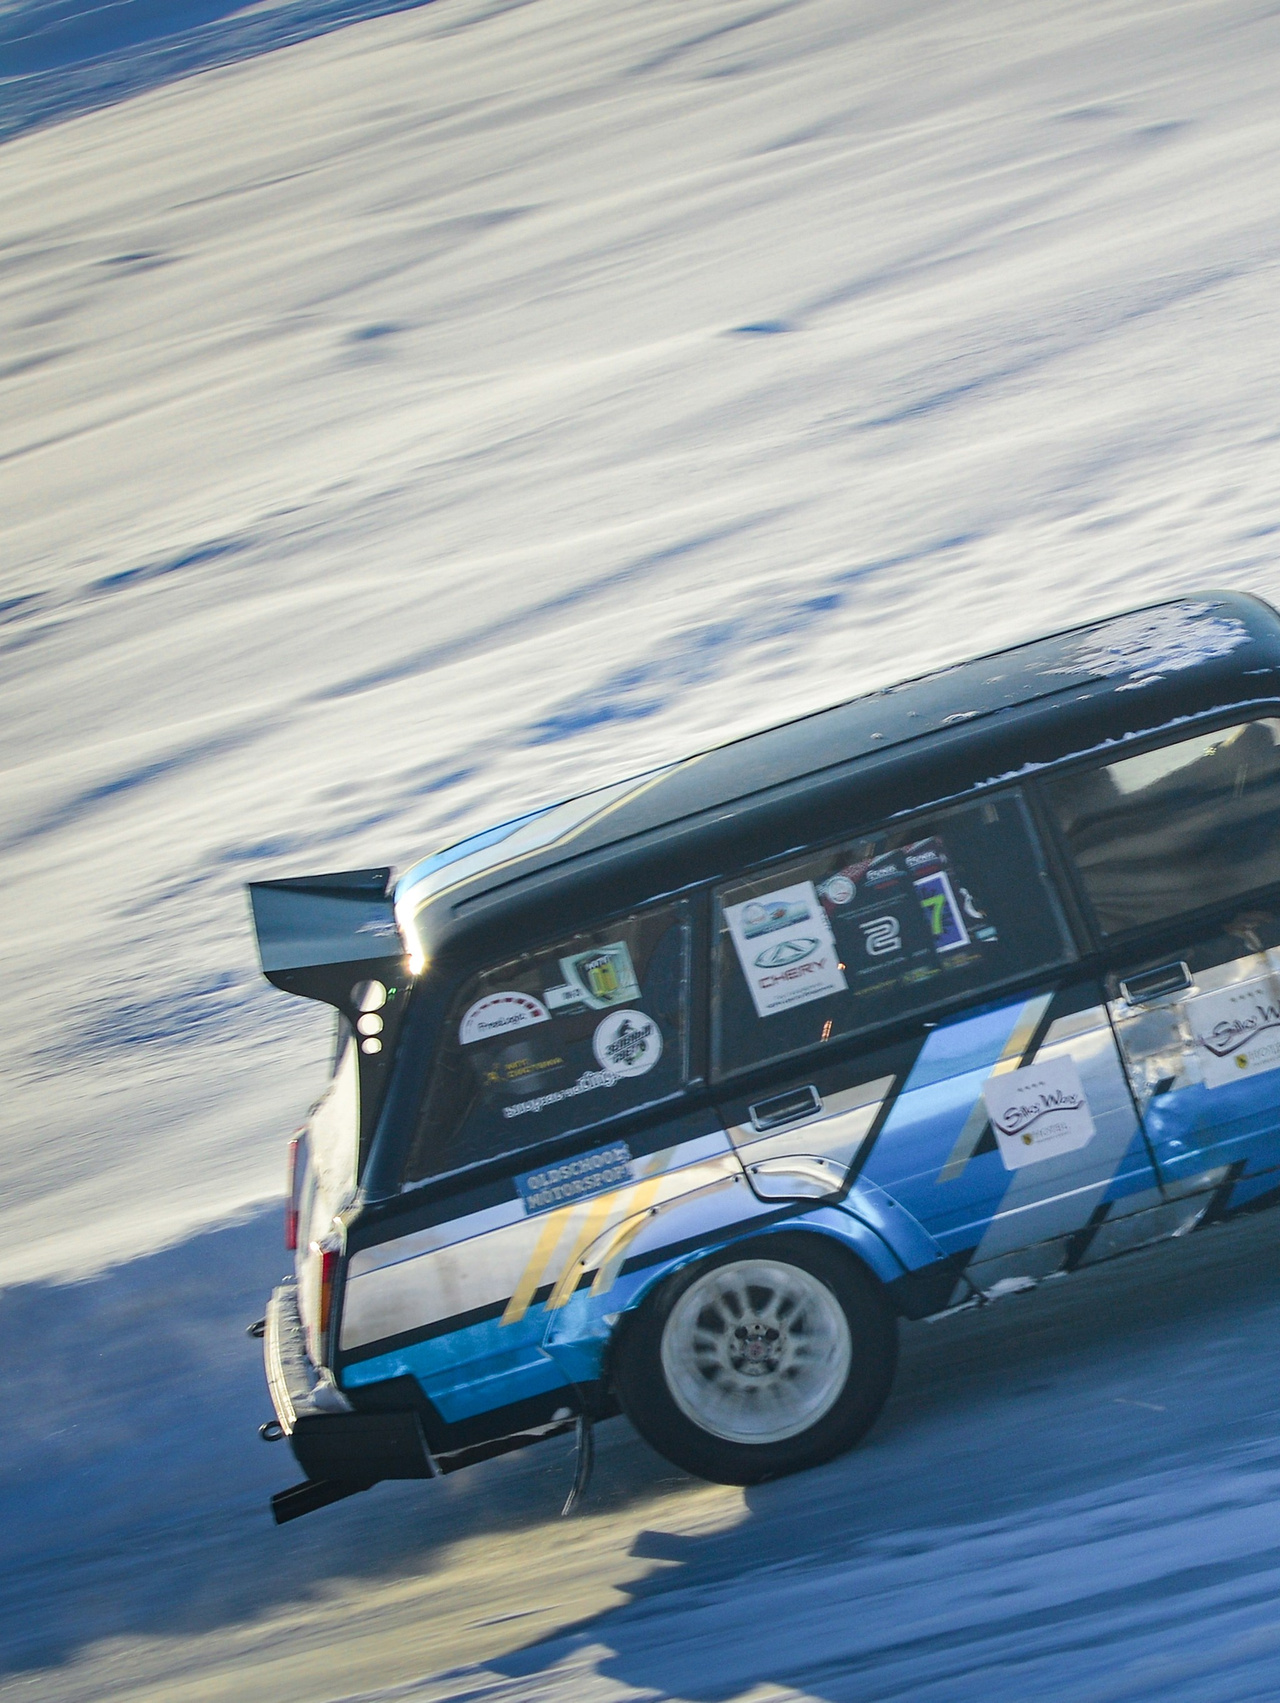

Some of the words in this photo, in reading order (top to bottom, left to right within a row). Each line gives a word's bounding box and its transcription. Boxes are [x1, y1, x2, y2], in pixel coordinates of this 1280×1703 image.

[921, 895, 945, 935] 7
[758, 957, 827, 989] CHERY
[1039, 1089, 1079, 1107] Way
